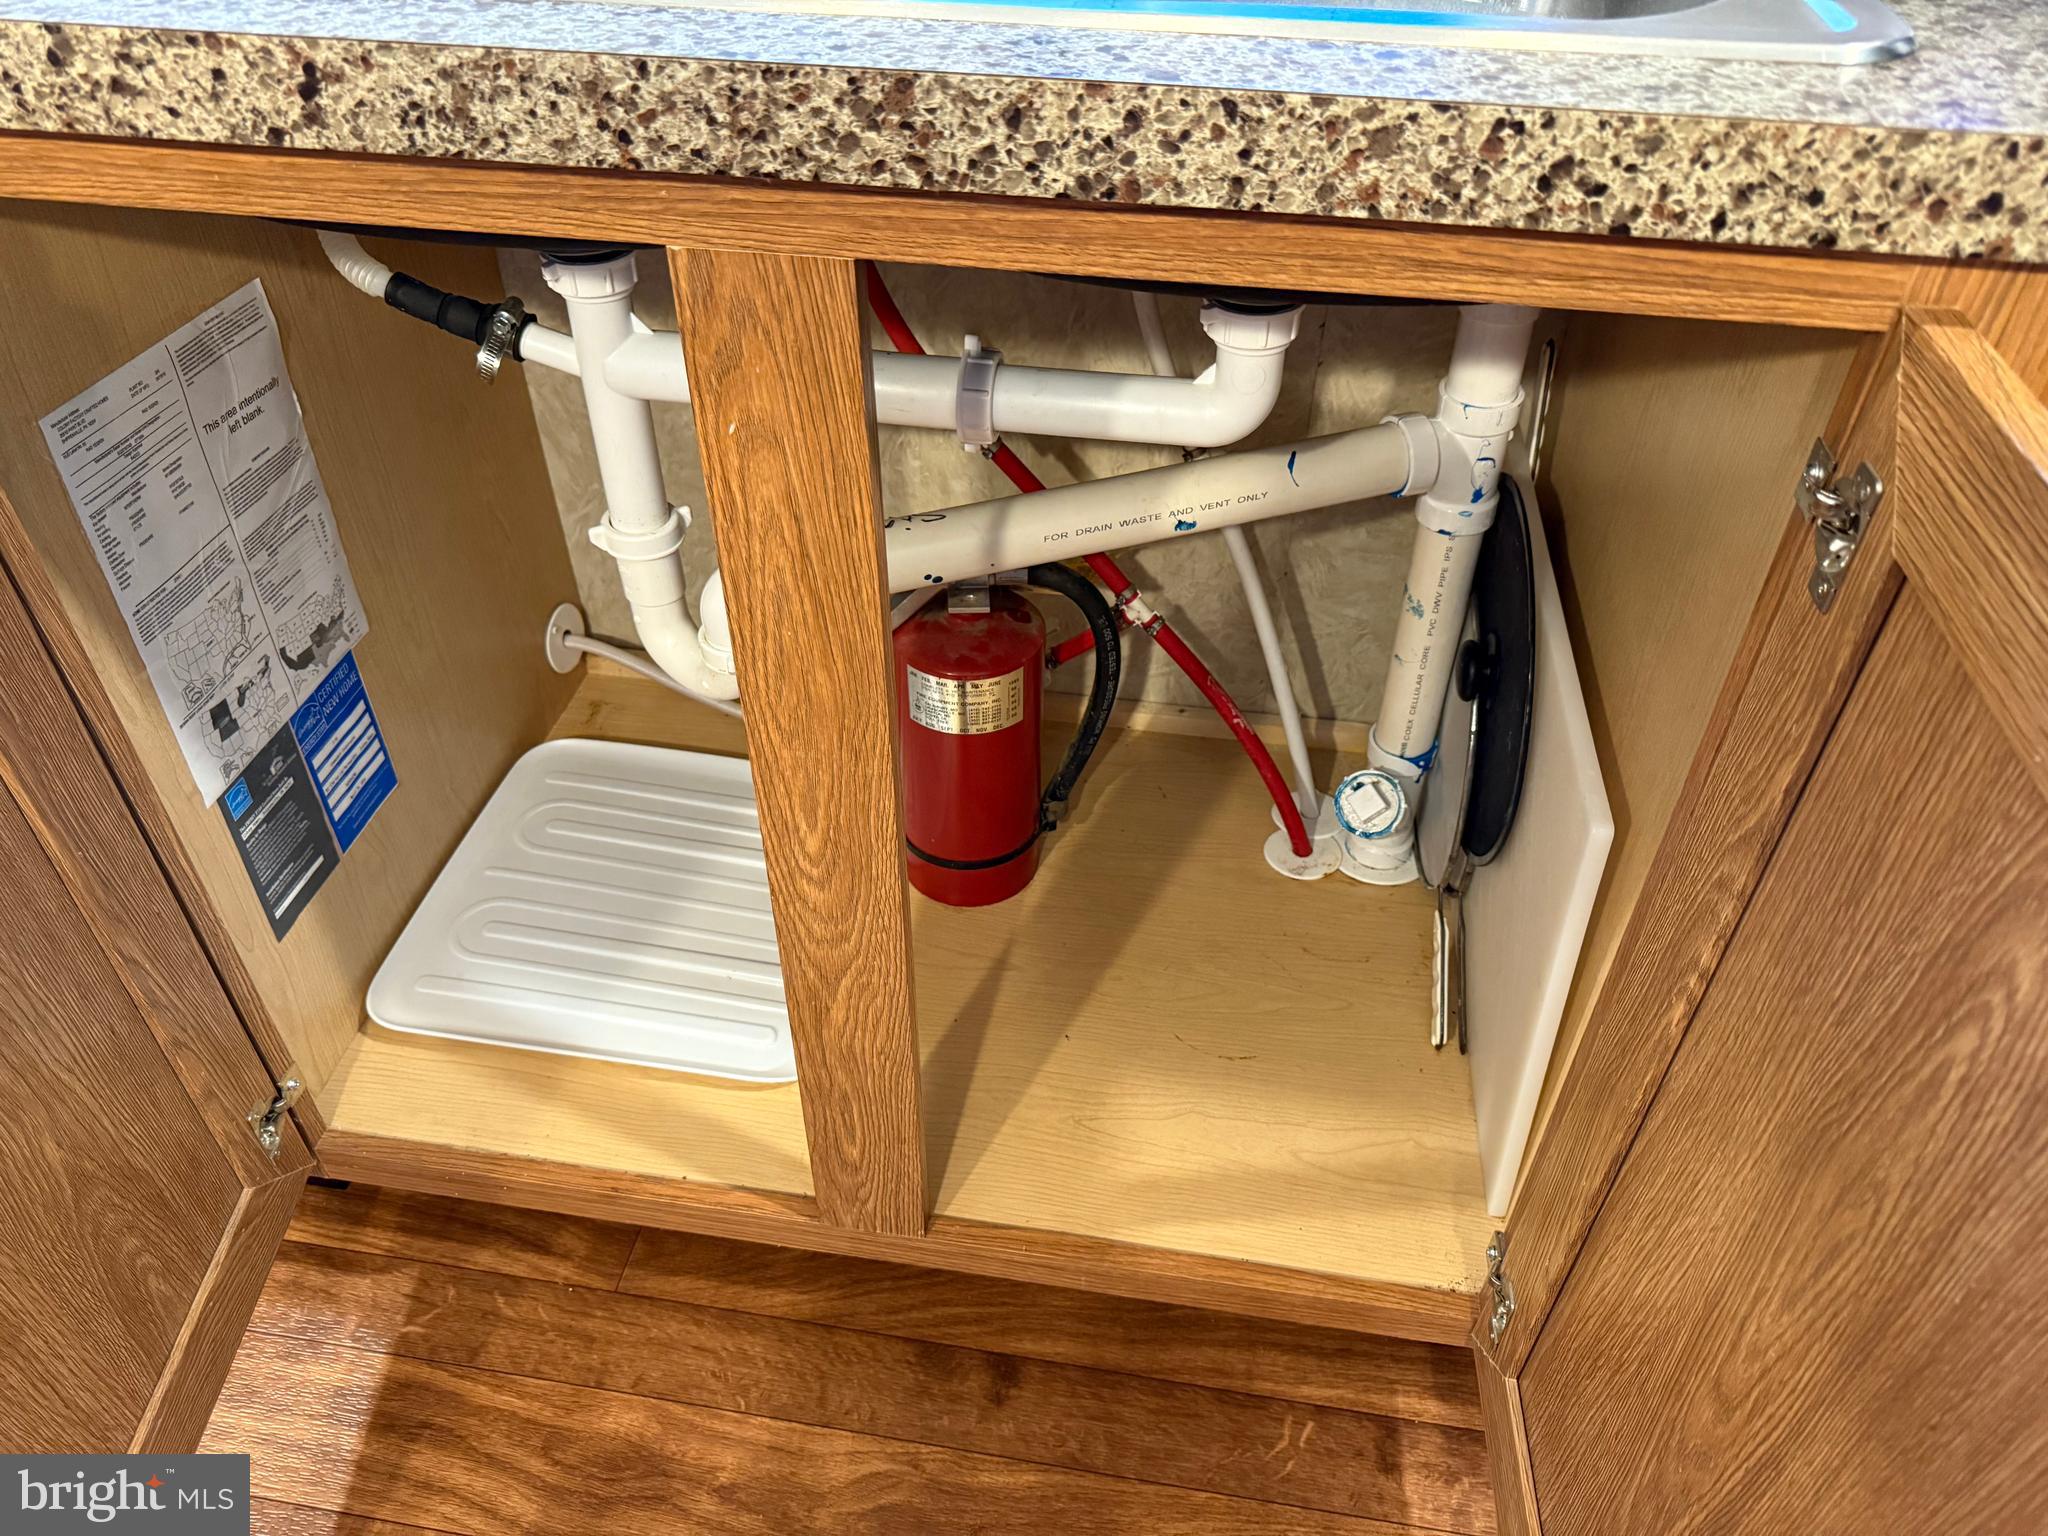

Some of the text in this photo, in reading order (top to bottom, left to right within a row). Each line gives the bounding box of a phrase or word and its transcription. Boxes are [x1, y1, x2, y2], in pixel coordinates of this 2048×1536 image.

[202, 376, 280, 435] This area intentionally
[228, 405, 265, 434] left blank.
[1043, 491, 1269, 543] FOR DRAIN WASTE AND VENT ONLY
[1409, 673, 1424, 716] CELLULAR
[1419, 645, 1431, 670] CORE
[1427, 618, 1437, 637] PVC
[1432, 592, 1443, 614] DWV
[1438, 566, 1448, 588] PIPE
[1443, 546, 1453, 561] IPS
[317, 662, 350, 703] CERTIFIED
[322, 671, 359, 717] NEW HOME
